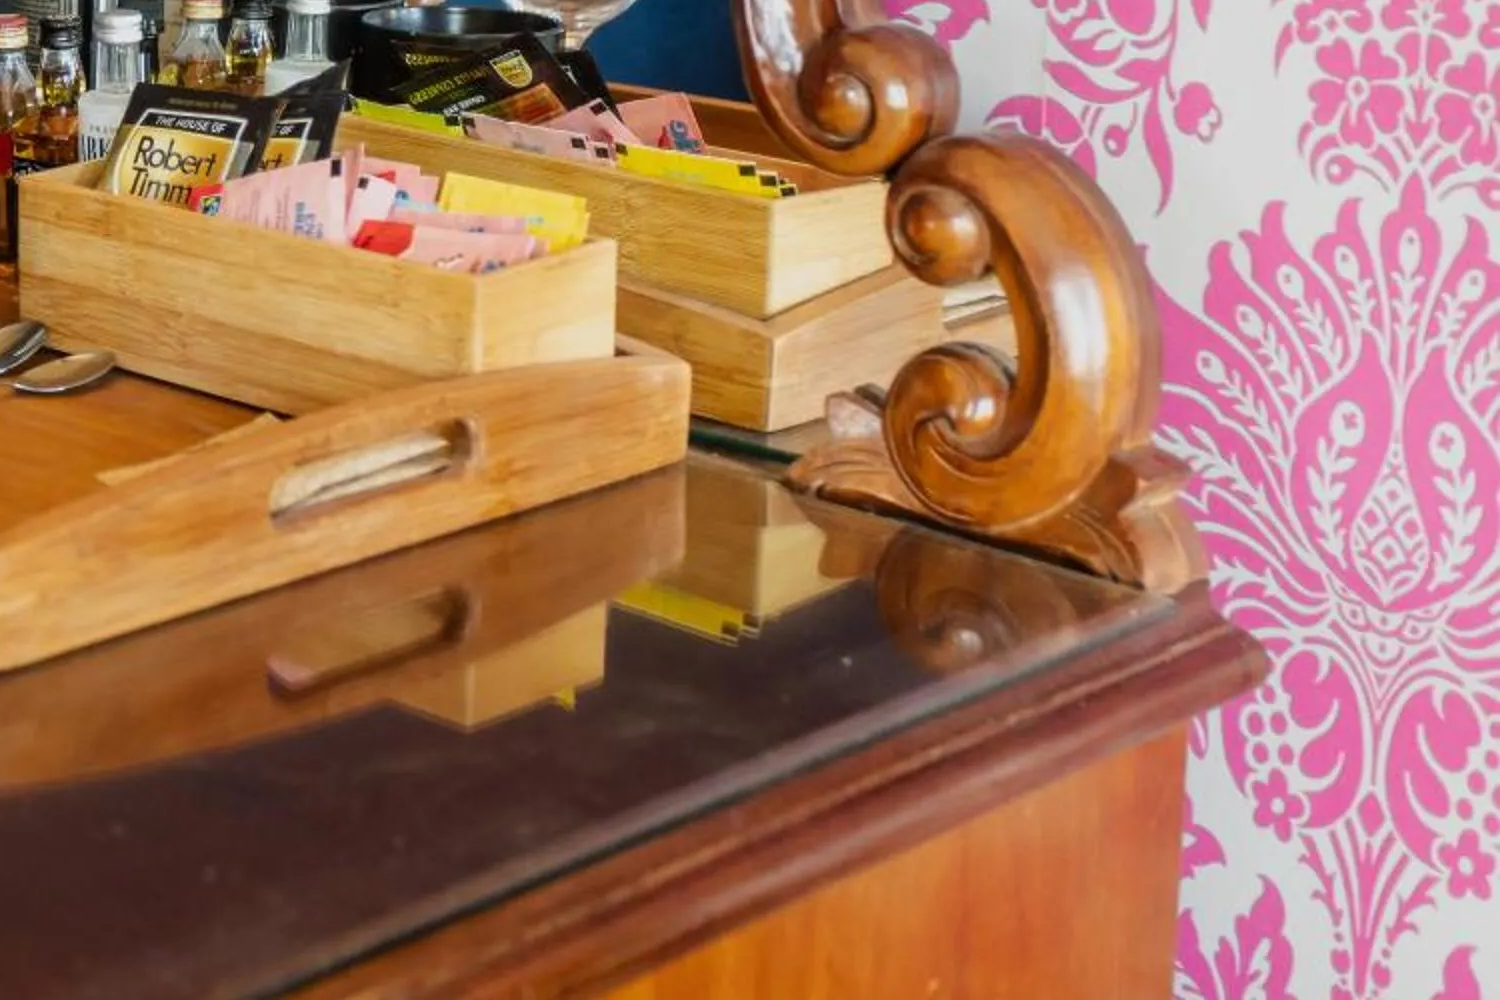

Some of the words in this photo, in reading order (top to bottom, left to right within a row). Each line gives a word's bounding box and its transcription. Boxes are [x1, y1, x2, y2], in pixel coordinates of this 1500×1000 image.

[155, 115, 174, 127] THE
[175, 119, 209, 132] HOUSE
[211, 122, 229, 134] OF
[133, 135, 217, 177] Robert
[129, 166, 193, 205] Timm
